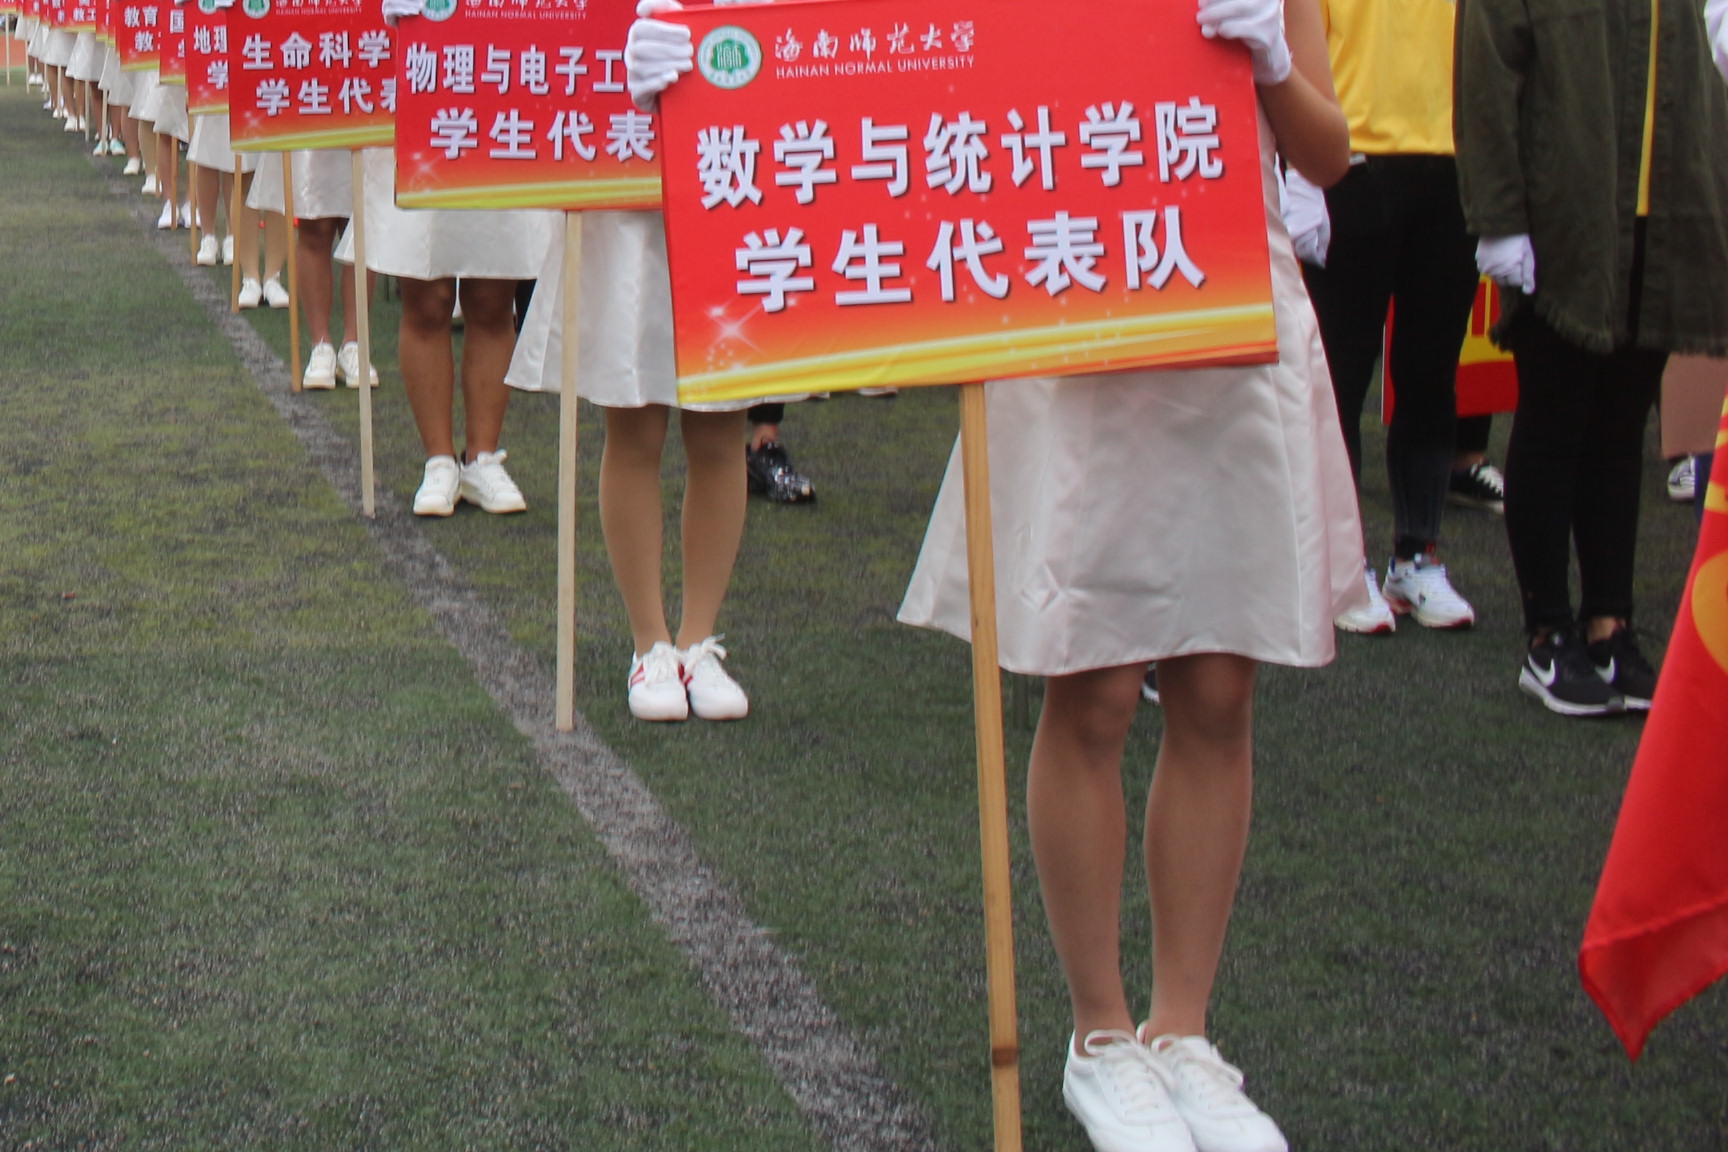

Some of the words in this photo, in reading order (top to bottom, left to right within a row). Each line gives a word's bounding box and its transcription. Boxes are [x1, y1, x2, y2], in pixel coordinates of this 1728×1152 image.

[124, 5, 158, 28] 教育
[465, 9, 498, 19] HAINAN
[501, 10, 537, 20] NORMAL
[539, 10, 588, 20] UNIVERSITY
[135, 31, 161, 52] 教
[242, 30, 391, 70] 生命科学
[774, 20, 974, 62] 海南师范大学
[405, 42, 624, 96] 物理与电子工
[776, 62, 830, 79] HAINAN
[834, 59, 893, 76] NORMAL
[897, 54, 975, 72] UNIVERSITY
[430, 107, 655, 162] 学生代表
[696, 96, 1224, 210] 数学与统计学院
[734, 205, 1206, 314] 学生代表队
